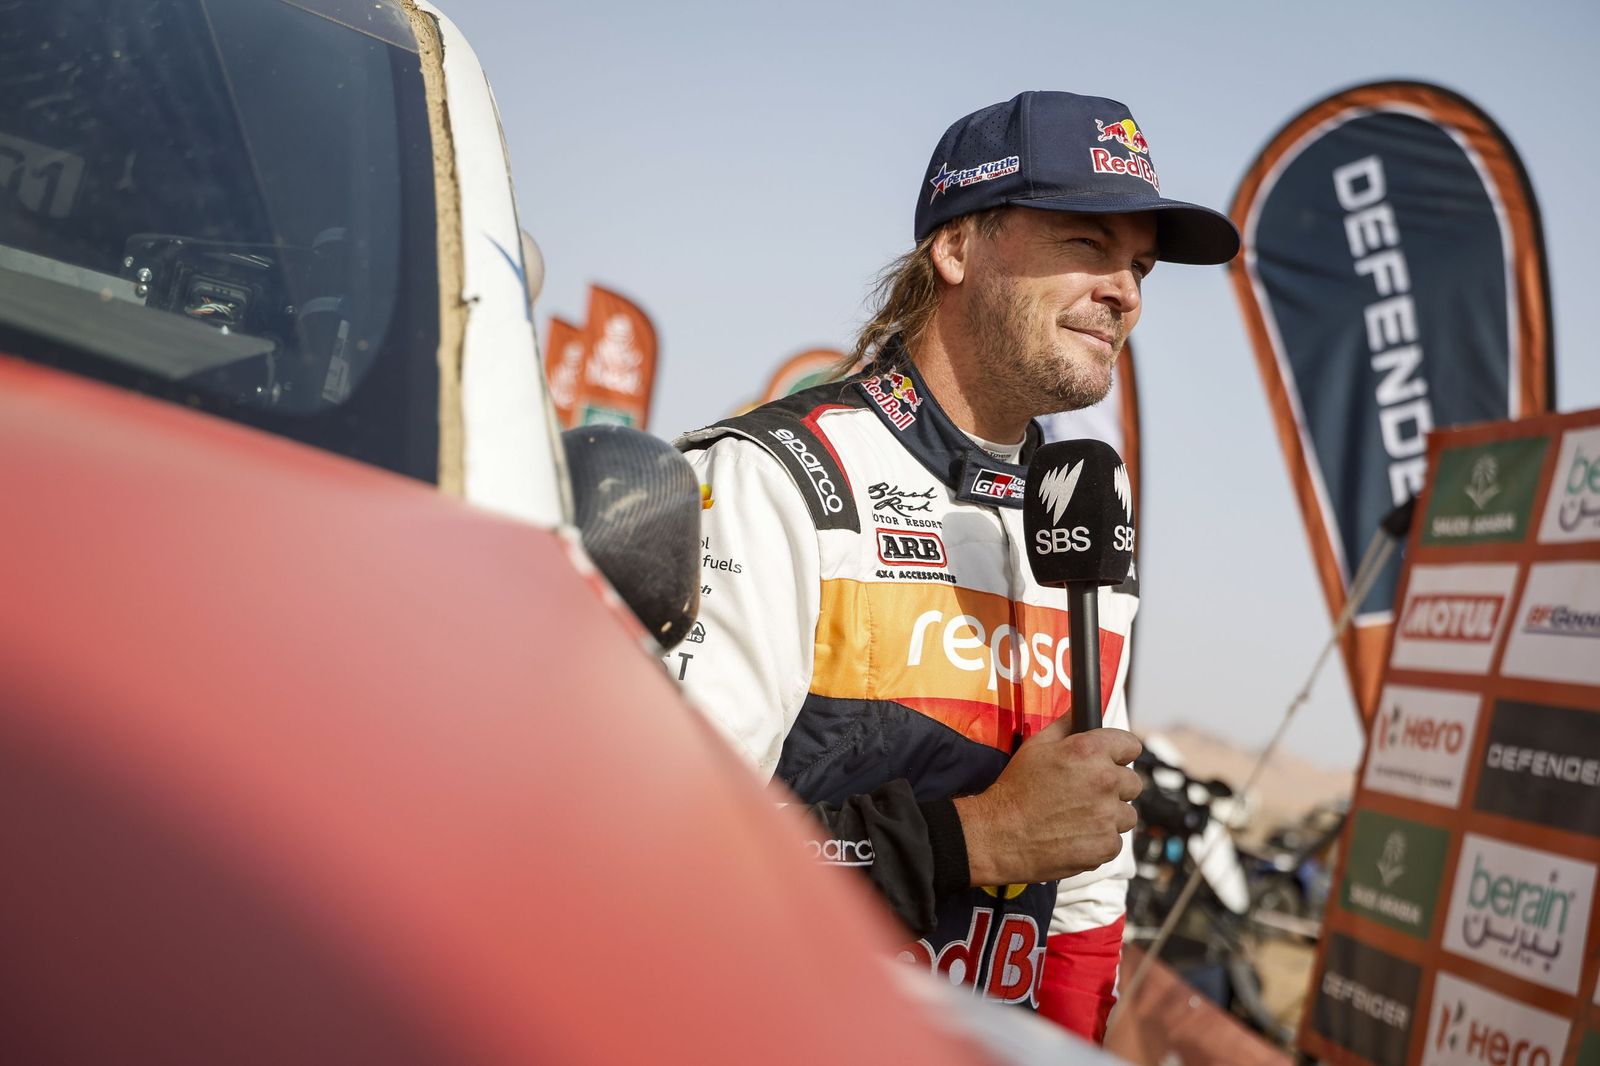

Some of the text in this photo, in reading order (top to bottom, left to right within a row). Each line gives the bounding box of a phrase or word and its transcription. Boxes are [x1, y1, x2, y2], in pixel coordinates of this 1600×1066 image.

[945, 156, 1018, 189] Peter Kittle
[962, 166, 1016, 187] MOTOR COMPANY
[1090, 147, 1142, 178] Red
[862, 375, 916, 431] Red Bull
[773, 428, 844, 514] sparco
[868, 482, 938, 500] Black
[975, 479, 1006, 497] GR
[872, 513, 942, 530] OTOR RESORT
[874, 497, 933, 518] Rock
[882, 534, 941, 561] ARB
[1035, 526, 1092, 555] SBS
[1113, 525, 1135, 553] SB
[702, 554, 742, 574] fuels
[876, 569, 957, 584] 4X4 ACCESSORIES
[1405, 600, 1498, 638] MOTUL
[1402, 715, 1465, 756] Hero
[1487, 743, 1600, 788] DEFENDE
[1467, 852, 1569, 936] berain
